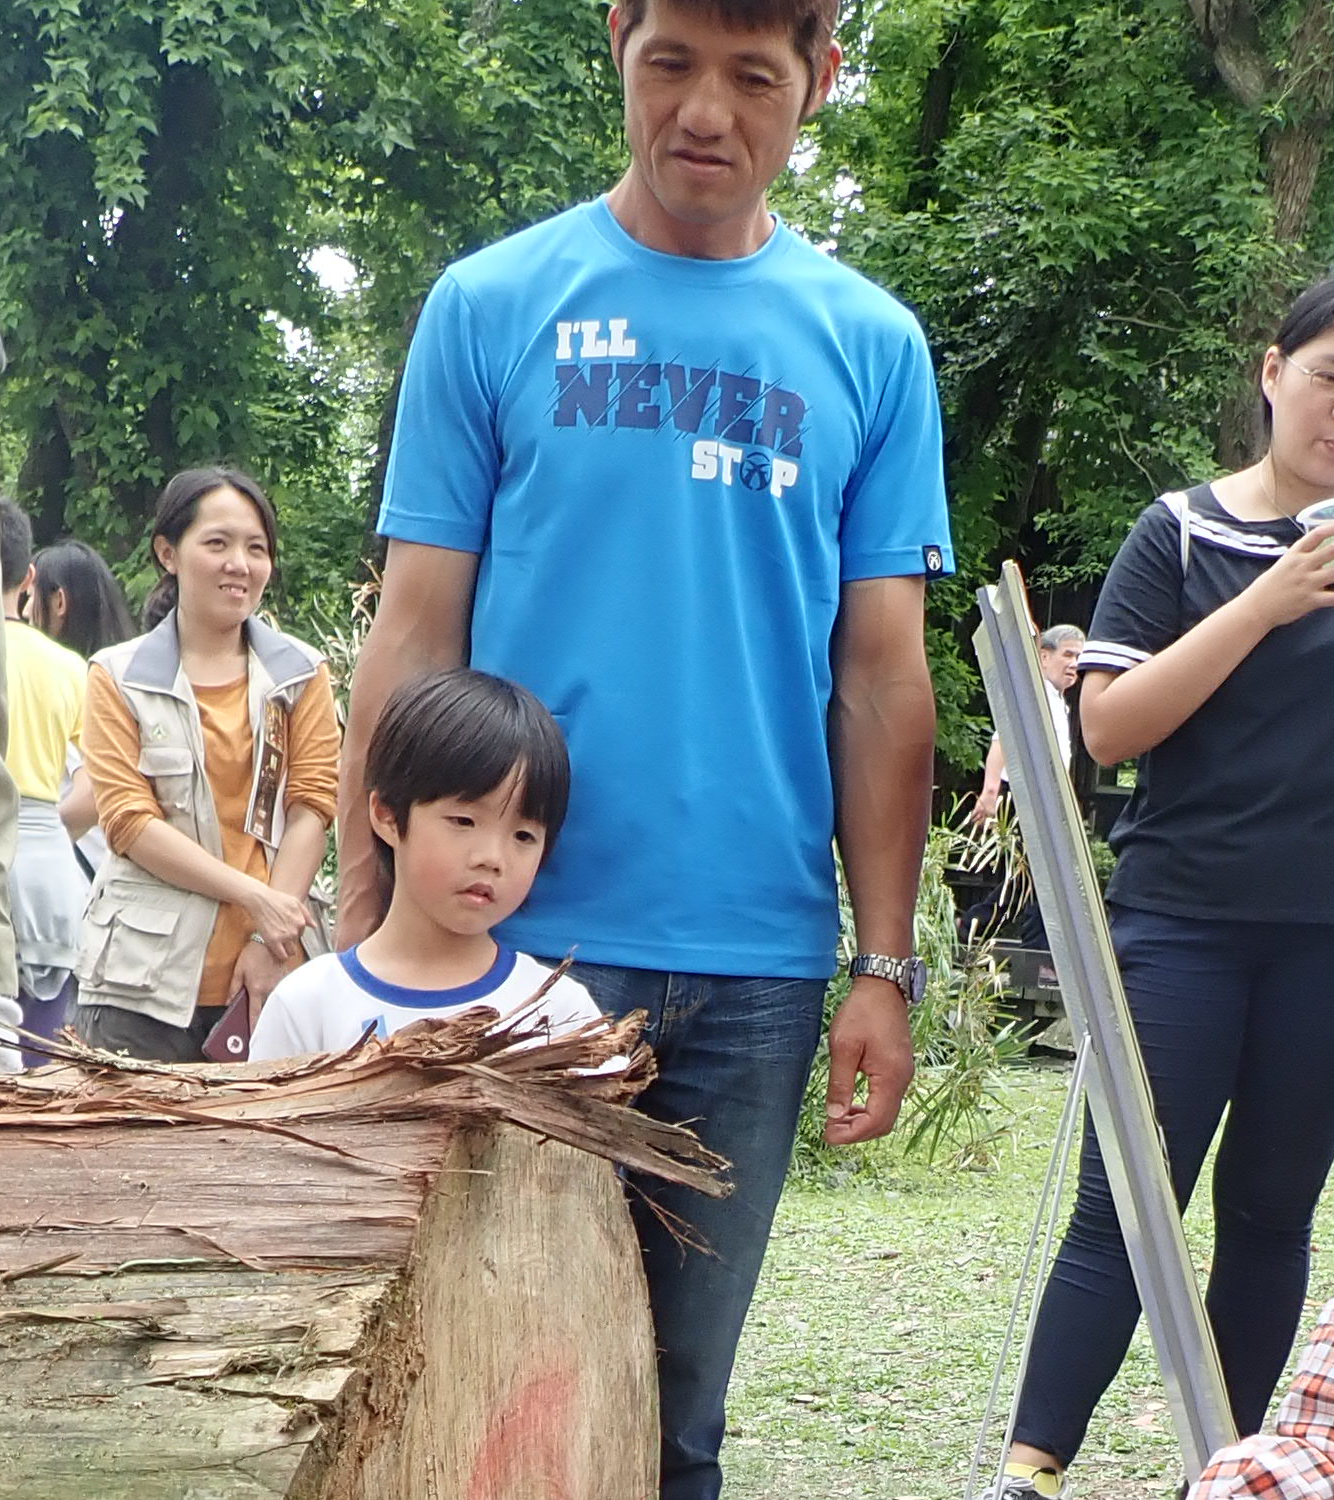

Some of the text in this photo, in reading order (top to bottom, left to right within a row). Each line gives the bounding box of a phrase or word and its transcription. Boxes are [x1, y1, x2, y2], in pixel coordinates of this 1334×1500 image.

[555, 318, 637, 360] I'LL
[552, 362, 809, 458] NEVER
[691, 440, 799, 499] STOP
